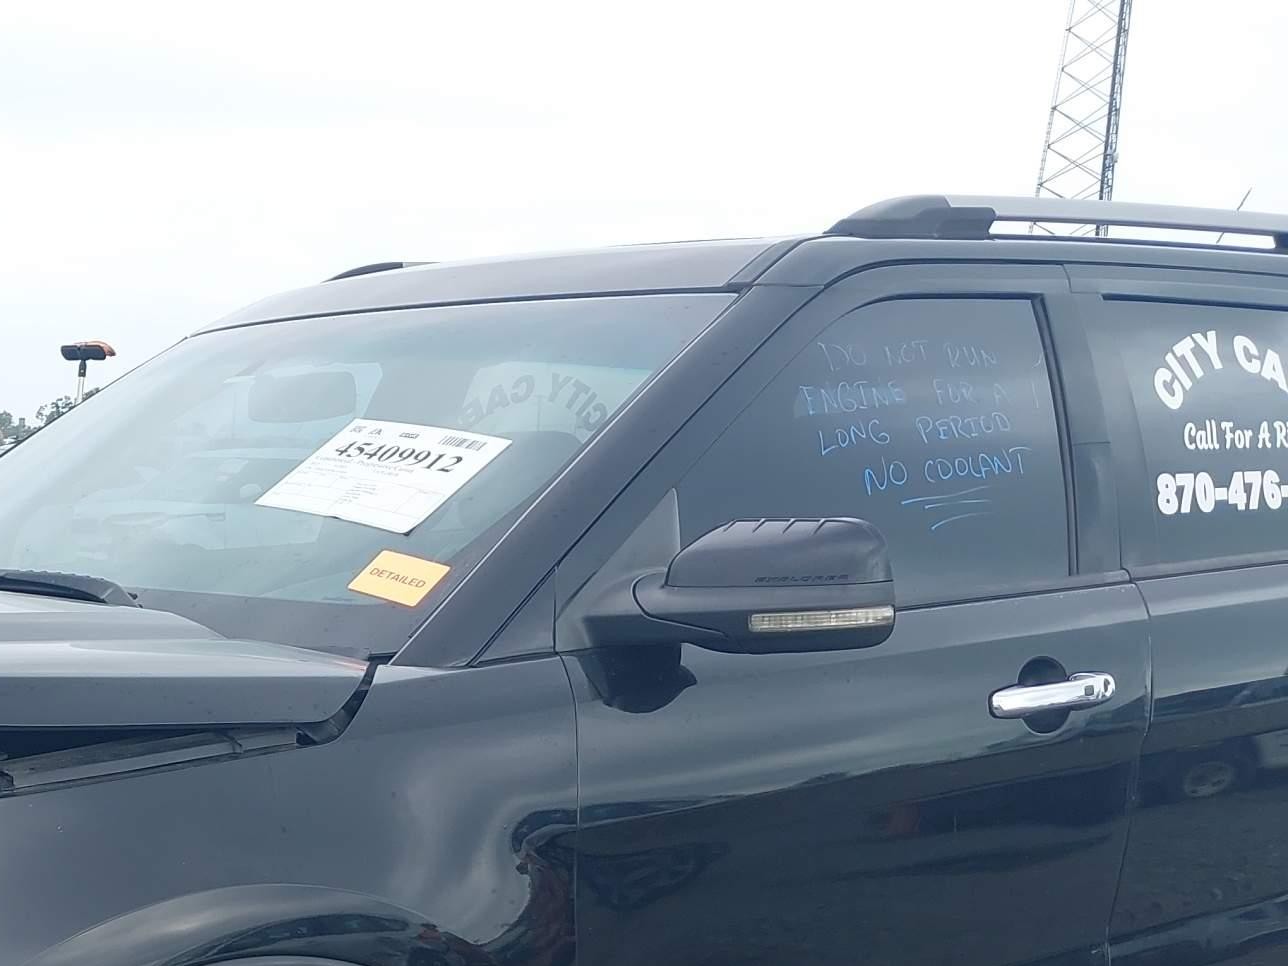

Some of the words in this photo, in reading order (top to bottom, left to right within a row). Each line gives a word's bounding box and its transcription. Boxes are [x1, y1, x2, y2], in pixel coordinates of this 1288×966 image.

[886, 340, 929, 366] NOT
[945, 343, 998, 368] RUN
[1154, 331, 1223, 410] CITY
[800, 380, 905, 416] ENGINE
[818, 419, 890, 456] LONG
[916, 412, 1012, 444] PERIOD
[1184, 419, 1219, 450] Call
[1221, 421, 1252, 449] For
[1257, 421, 1271, 449] A
[335, 440, 463, 473] 45409912
[864, 456, 908, 496] NO
[925, 447, 1032, 483] COOLANT
[369, 566, 426, 589] DETAILED
